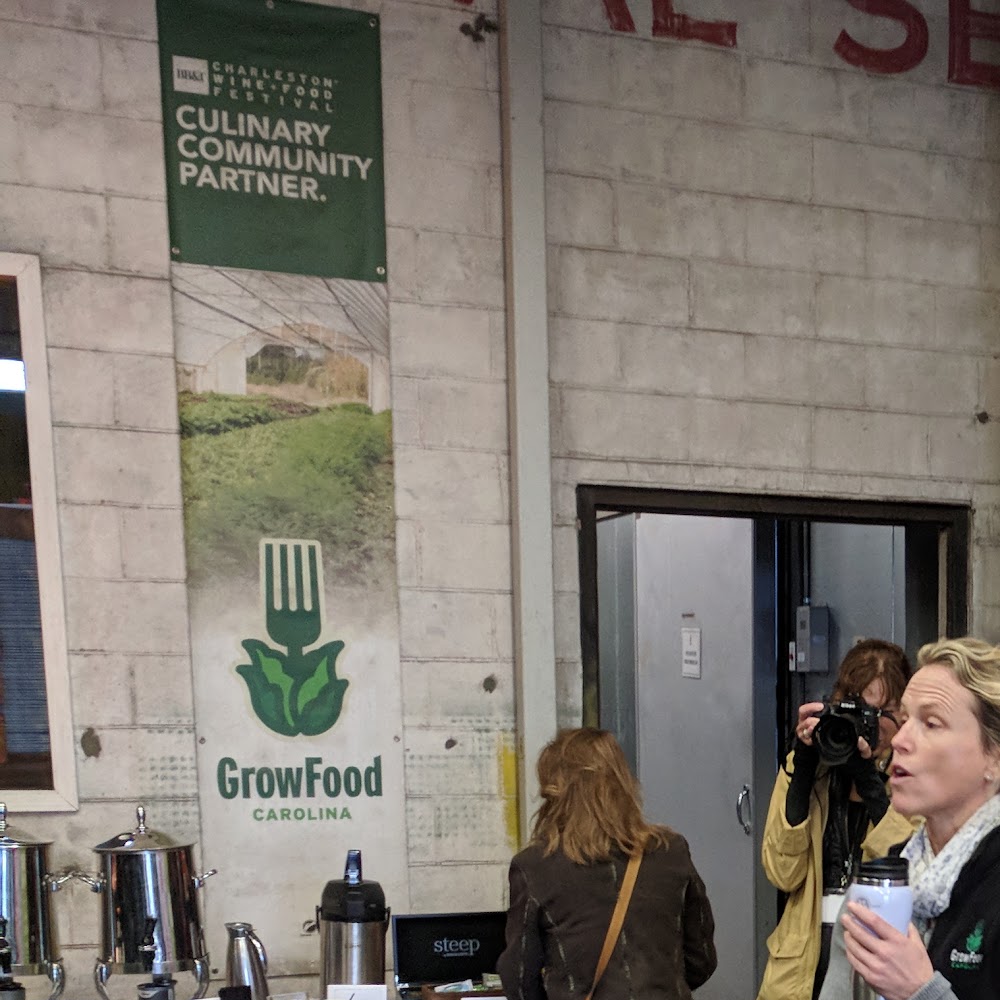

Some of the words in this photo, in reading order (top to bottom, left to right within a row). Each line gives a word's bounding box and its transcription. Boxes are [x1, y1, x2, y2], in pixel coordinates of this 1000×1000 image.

[212, 61, 333, 88] CHARLESTON
[213, 74, 264, 91] WINE
[282, 84, 333, 100] FOOD
[213, 86, 334, 114] FESTIVAL
[176, 105, 331, 147] CULINARY
[177, 134, 373, 180] COMMUNITY
[179, 161, 327, 202] PARTNER.
[216, 755, 383, 800] GrowFood
[252, 806, 352, 822] CAROLINA
[434, 937, 481, 957] steep
